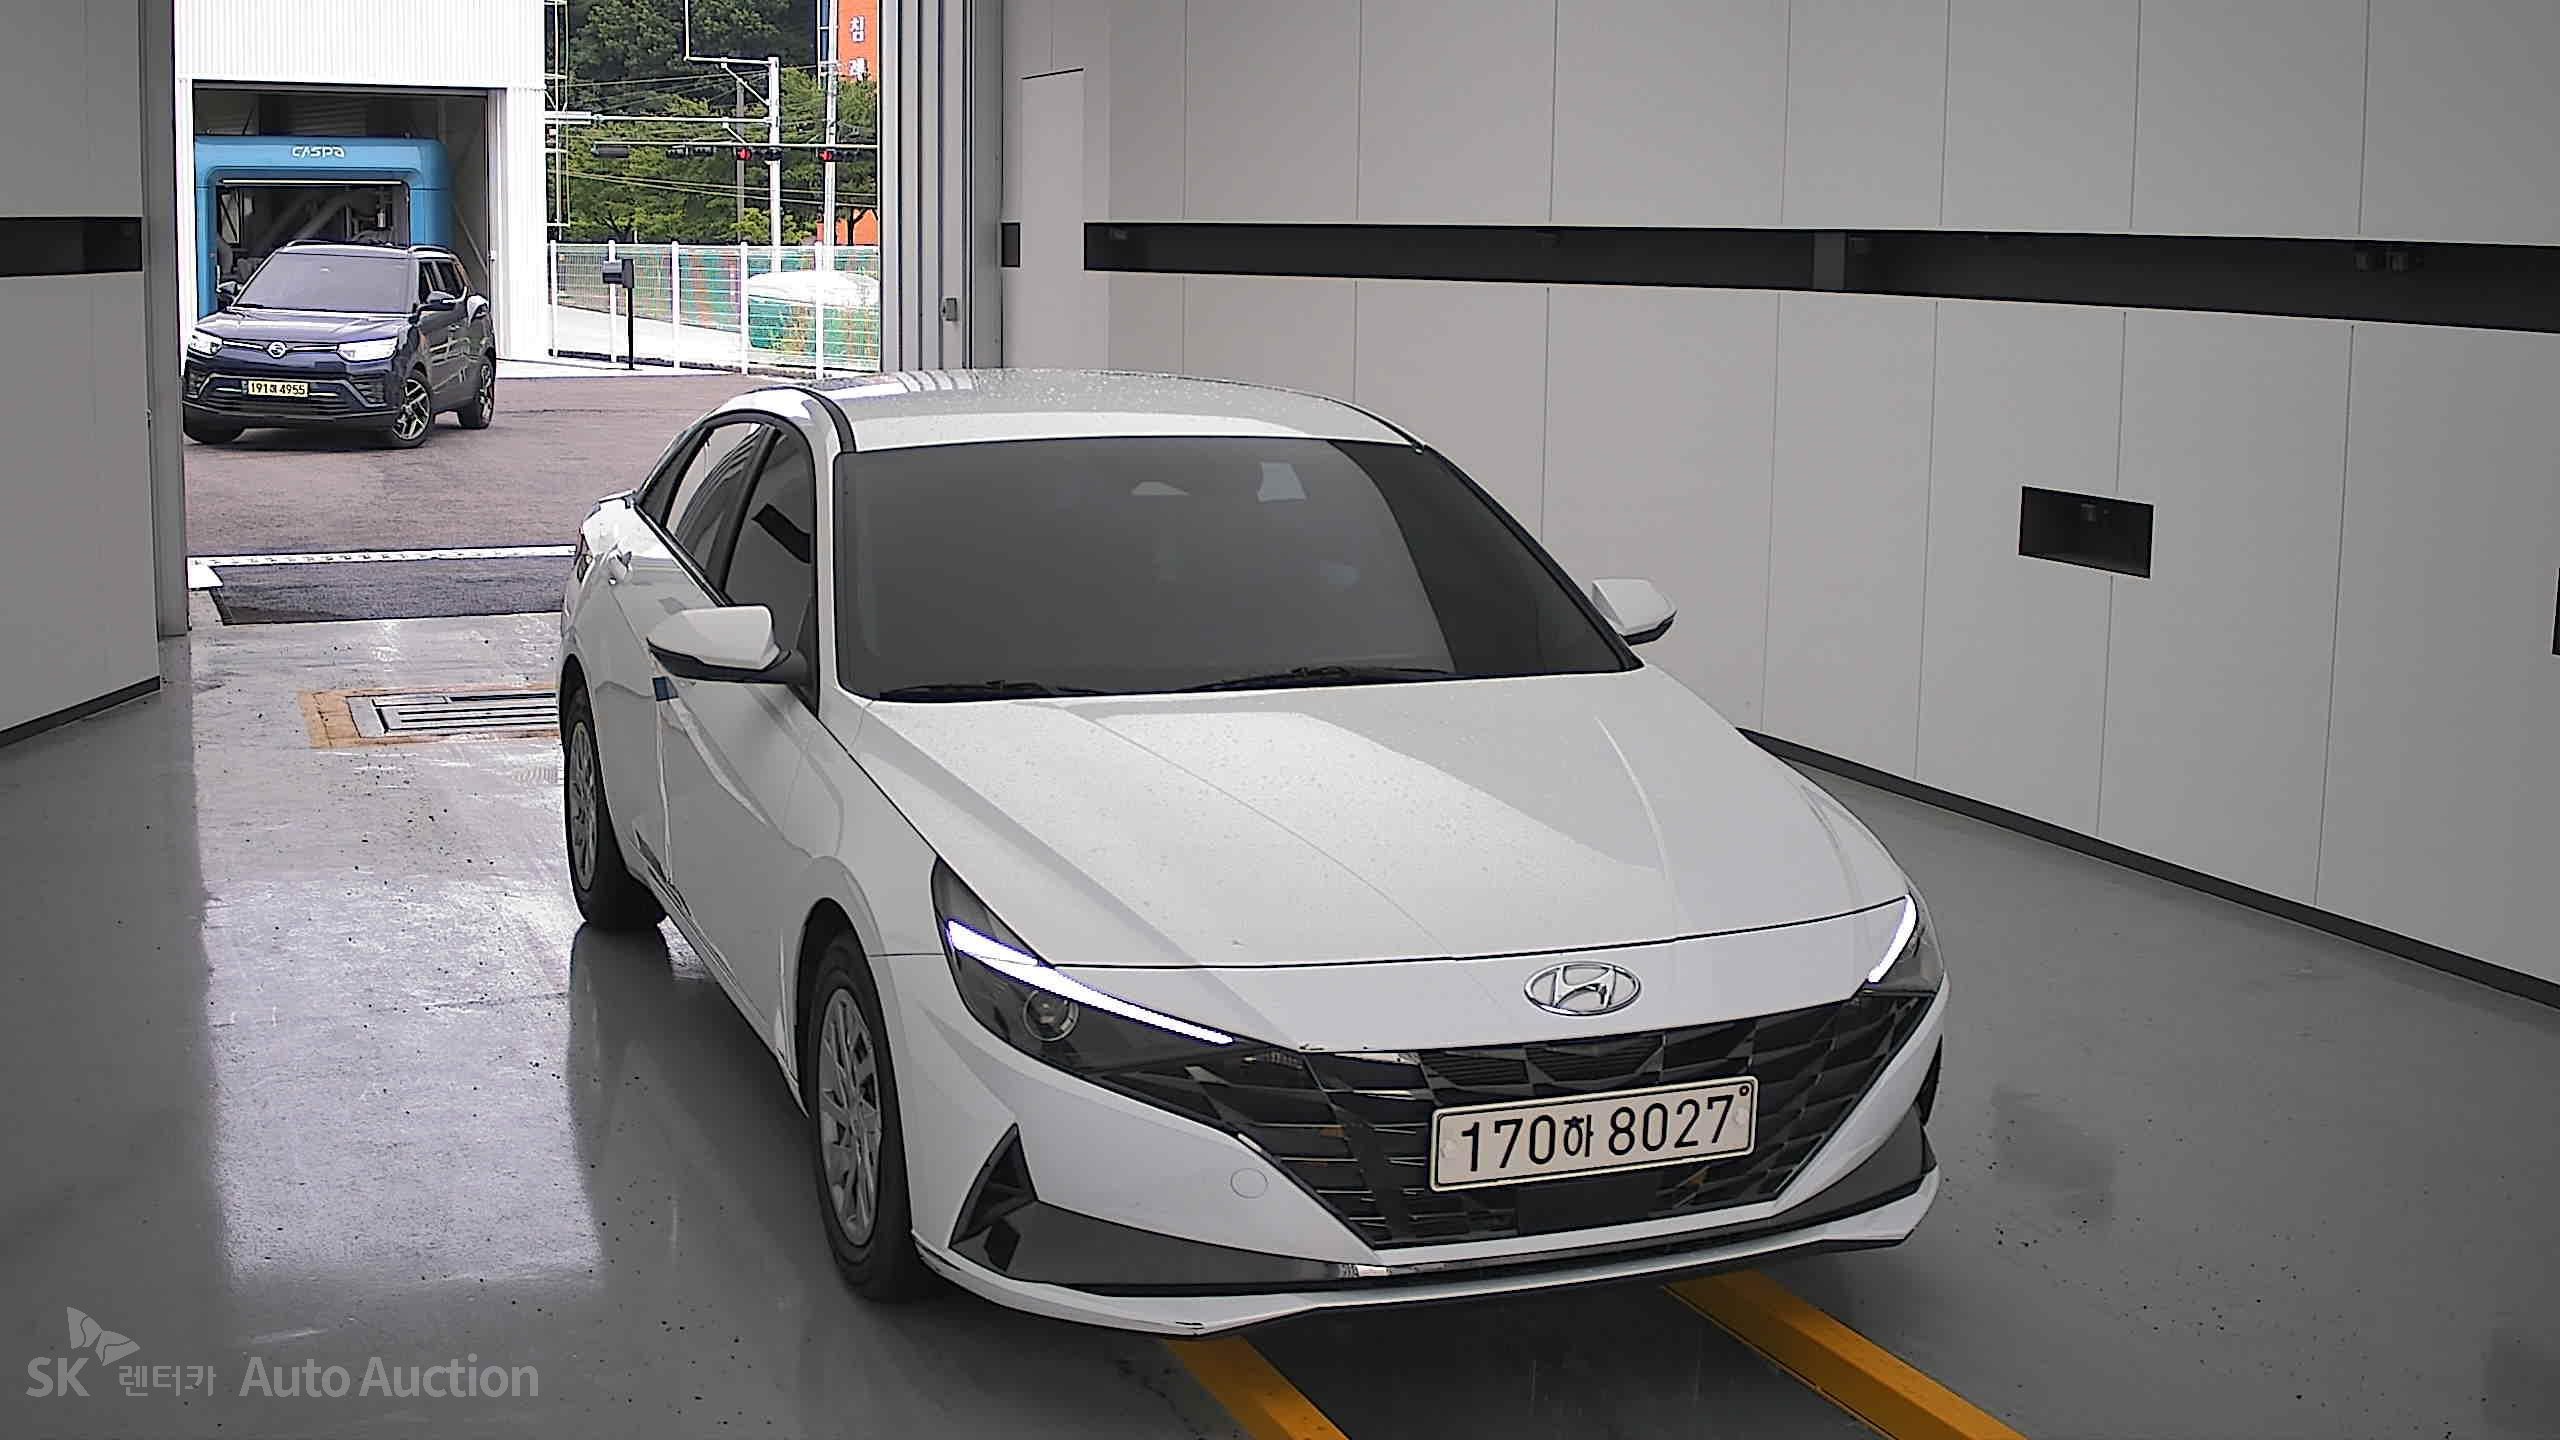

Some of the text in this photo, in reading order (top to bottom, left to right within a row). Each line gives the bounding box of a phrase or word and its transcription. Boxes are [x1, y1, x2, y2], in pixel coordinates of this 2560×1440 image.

[279, 384, 305, 394] 4955
[1461, 1095, 1734, 1172] 170하 8027
